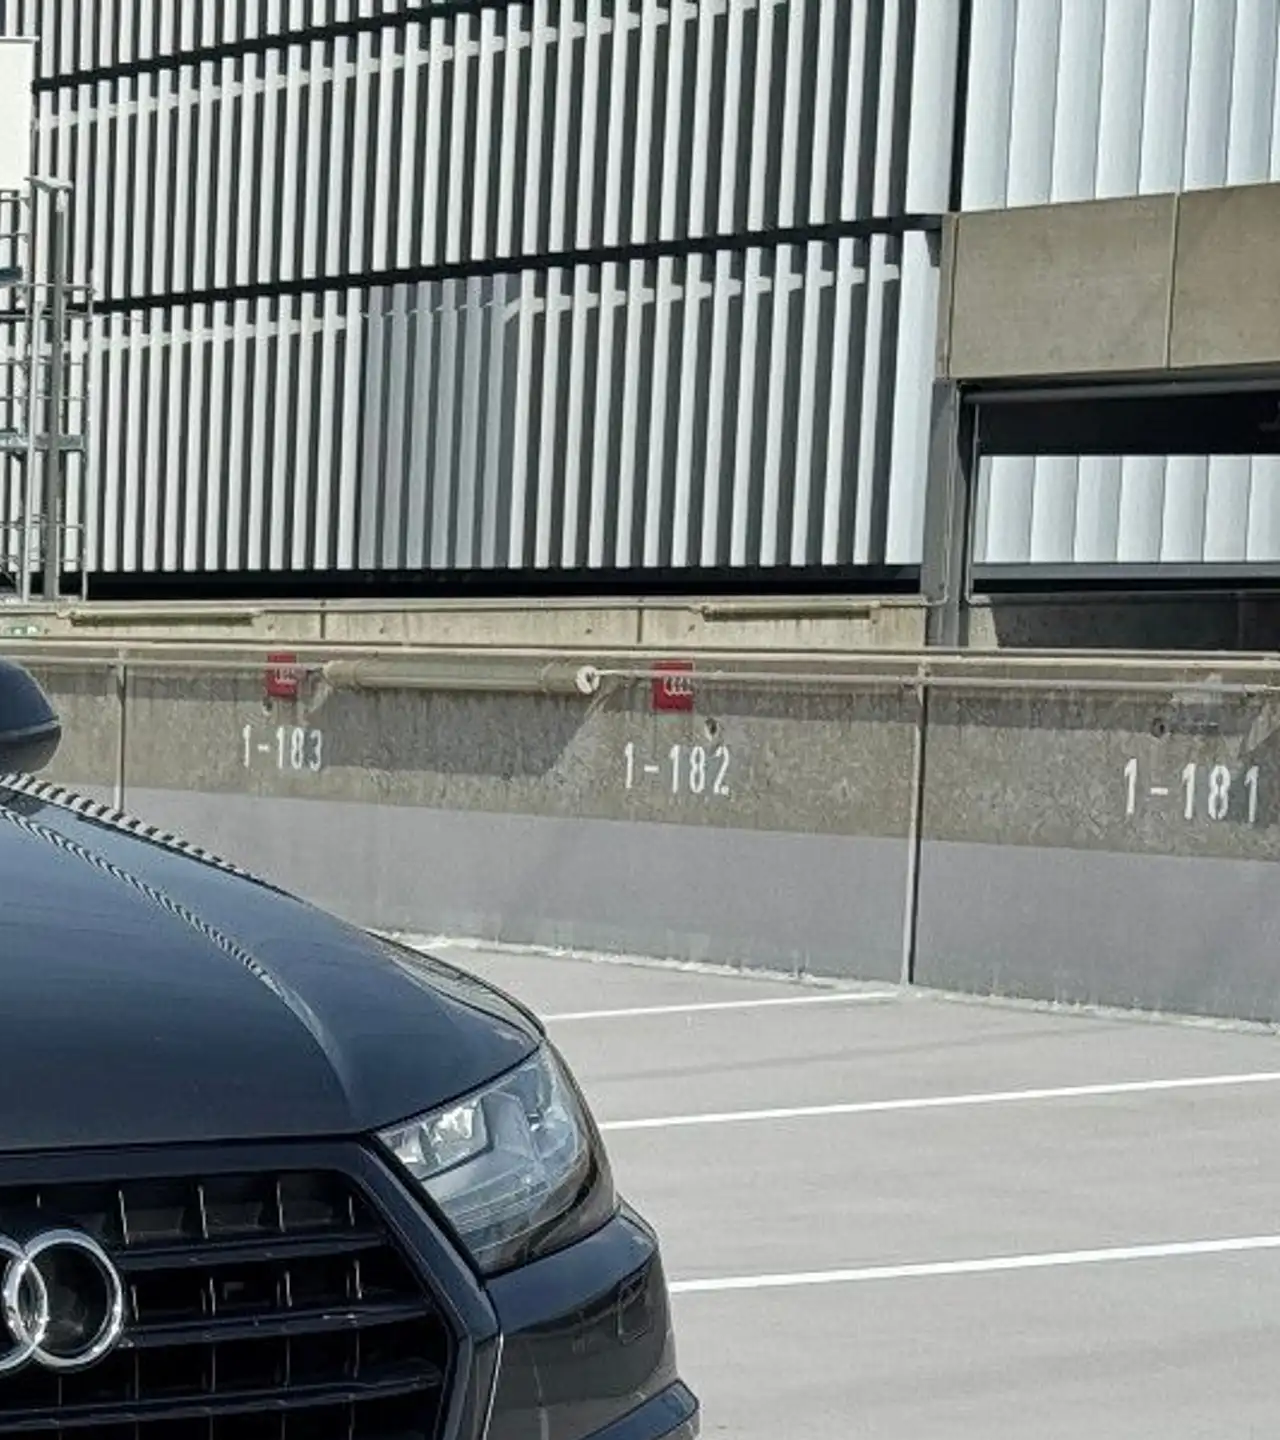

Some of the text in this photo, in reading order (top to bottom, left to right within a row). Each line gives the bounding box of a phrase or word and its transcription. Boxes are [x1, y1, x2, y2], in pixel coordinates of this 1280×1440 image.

[242, 723, 323, 773] 1-183
[624, 741, 730, 796] 1-182
[1123, 757, 1261, 824] 1-181
